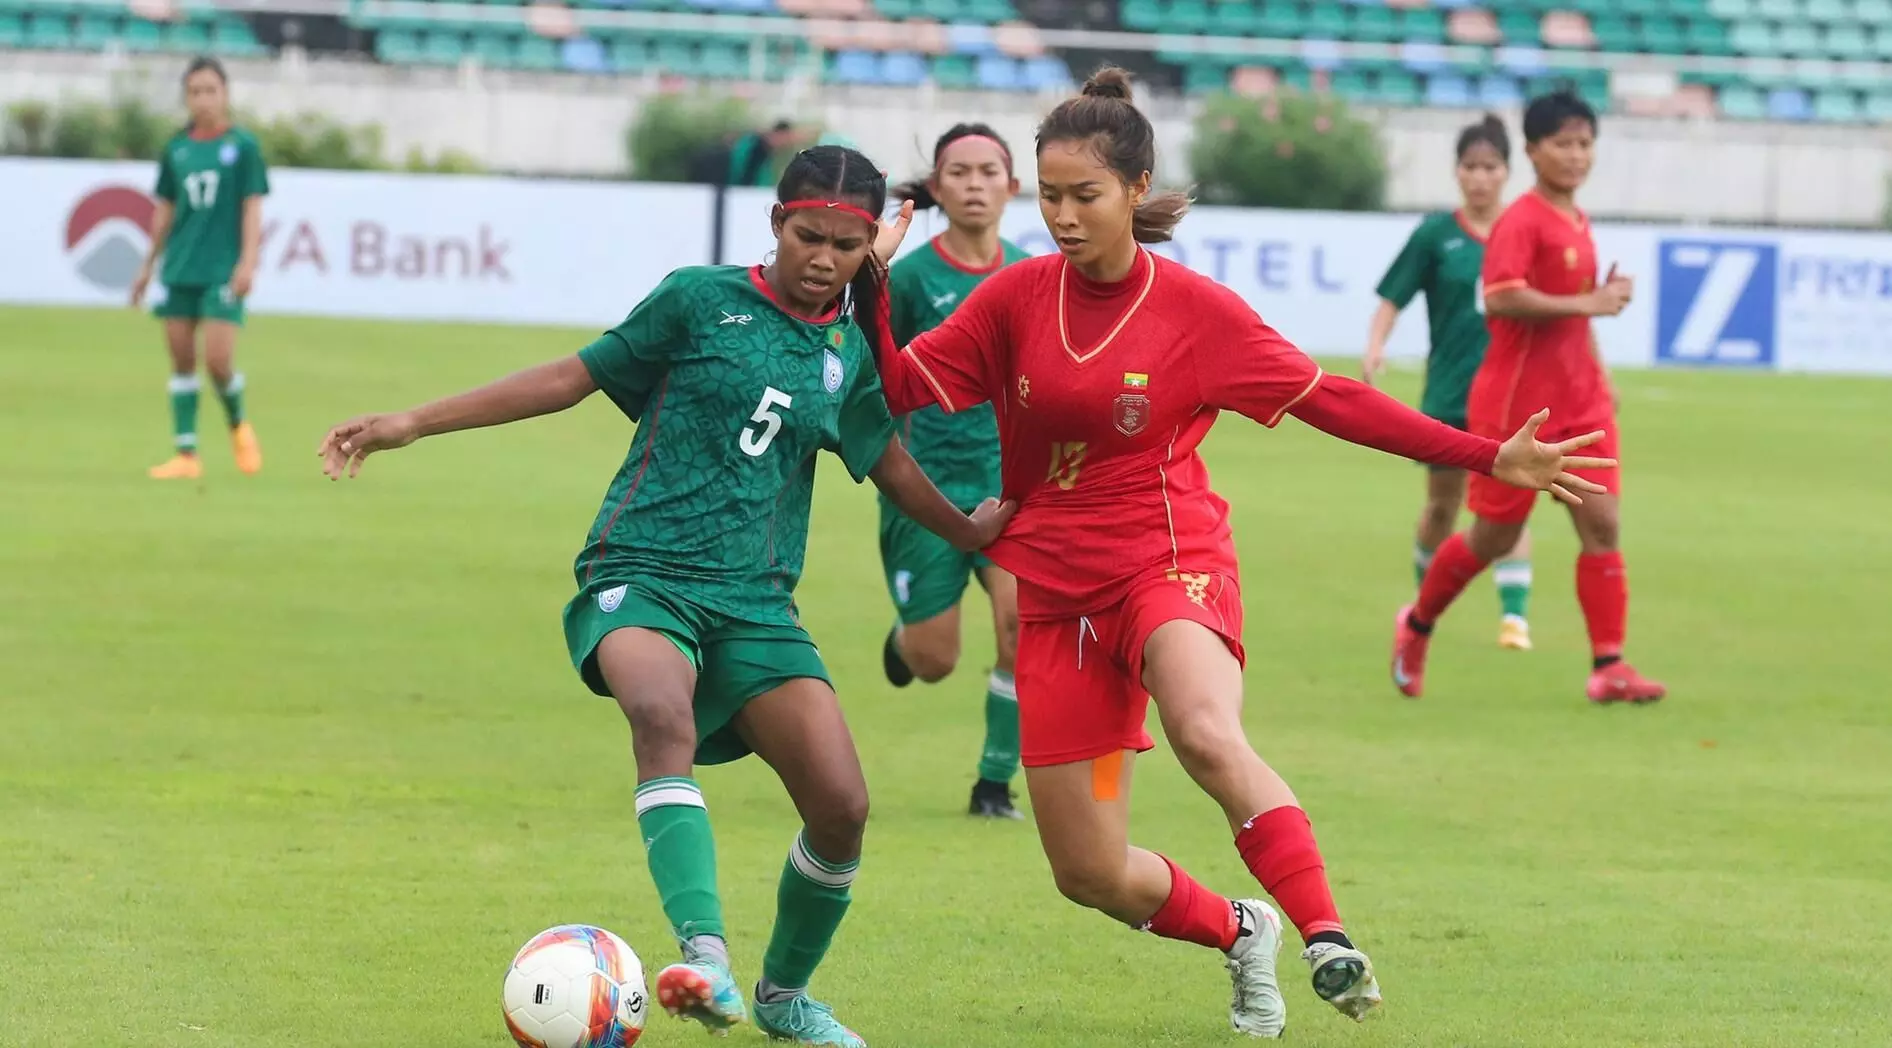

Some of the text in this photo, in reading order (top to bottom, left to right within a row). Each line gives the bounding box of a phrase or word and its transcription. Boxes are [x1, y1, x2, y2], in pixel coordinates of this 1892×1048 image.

[184, 168, 220, 212] 17
[349, 219, 514, 284] Bank
[1670, 247, 1762, 359] Z
[739, 385, 793, 457] 5
